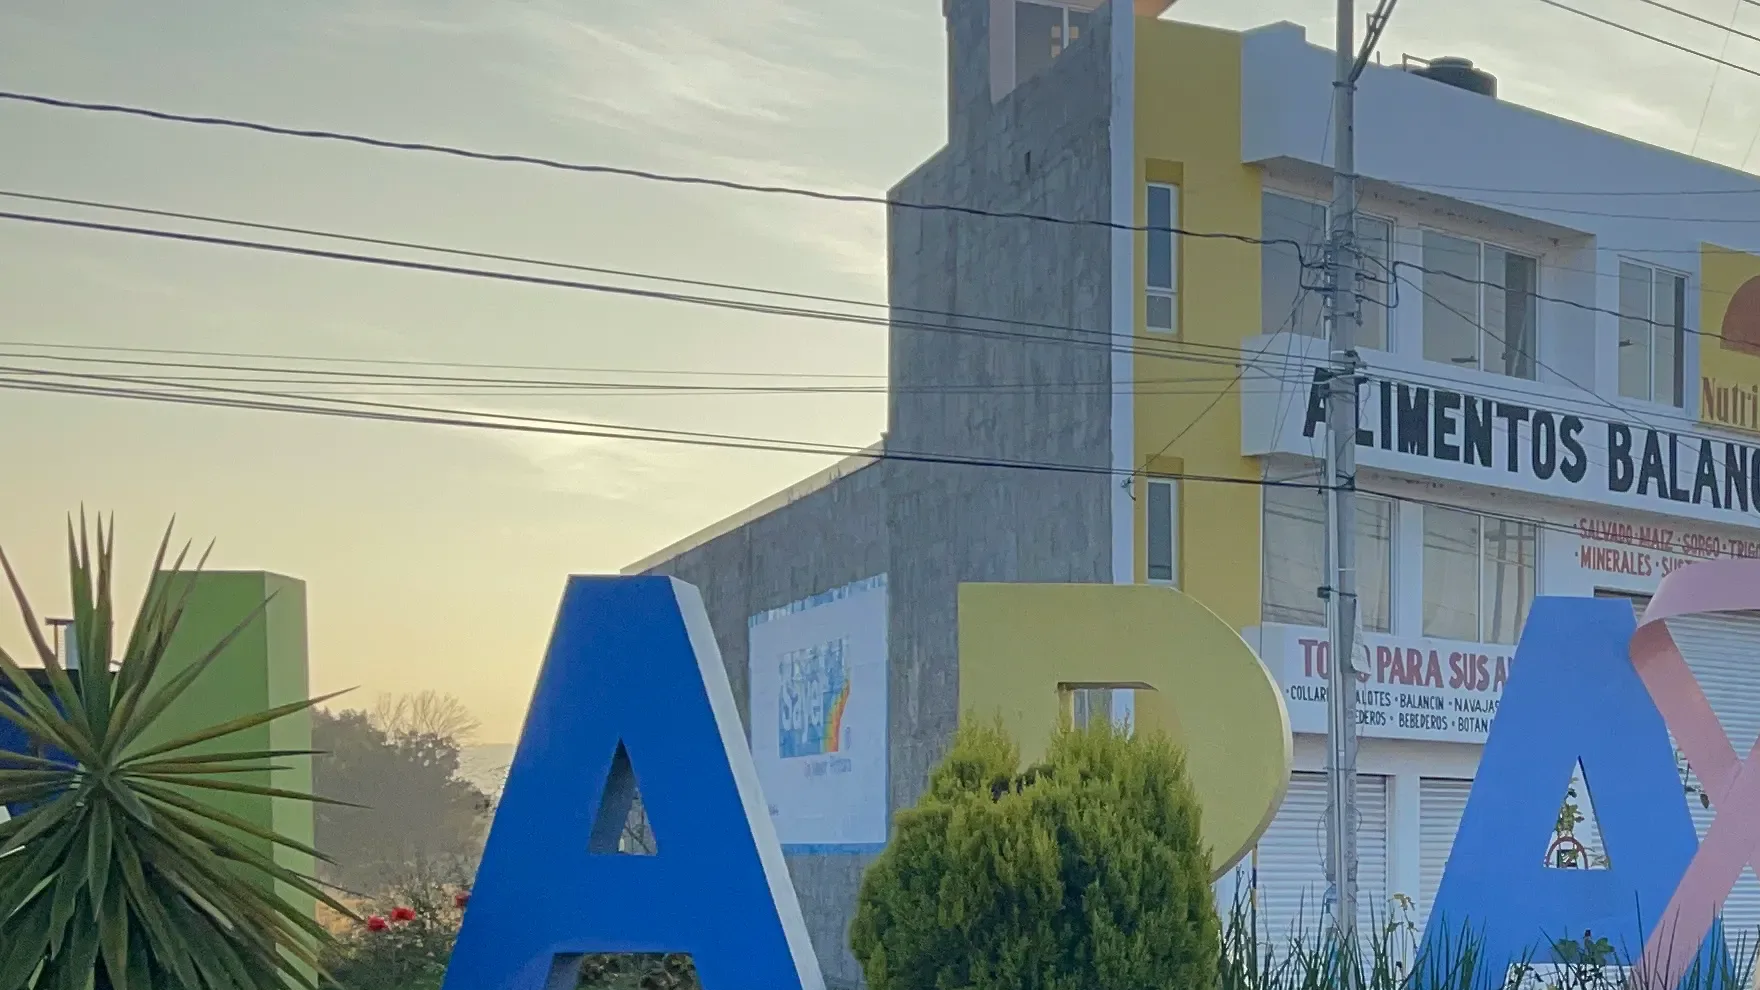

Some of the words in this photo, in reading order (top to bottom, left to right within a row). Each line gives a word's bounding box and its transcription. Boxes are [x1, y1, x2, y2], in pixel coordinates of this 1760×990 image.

[1701, 376, 1758, 429] Nutri
[1303, 367, 1587, 483] ALIMENTOS
[1580, 518, 1633, 544] SALVADO
[1640, 526, 1673, 551] MAIZ
[1580, 545, 1652, 576] MINERALES
[1299, 639, 1371, 683] TO
[1377, 646, 1444, 688] PARA
[1449, 651, 1490, 692] SUS
[1291, 685, 1329, 701] COLLAR
[1356, 690, 1391, 707] ALOTES
[1400, 693, 1444, 710] BALANCIN
[1399, 713, 1448, 730] BEBEDEROS
[1458, 716, 1493, 732] BOTAN
